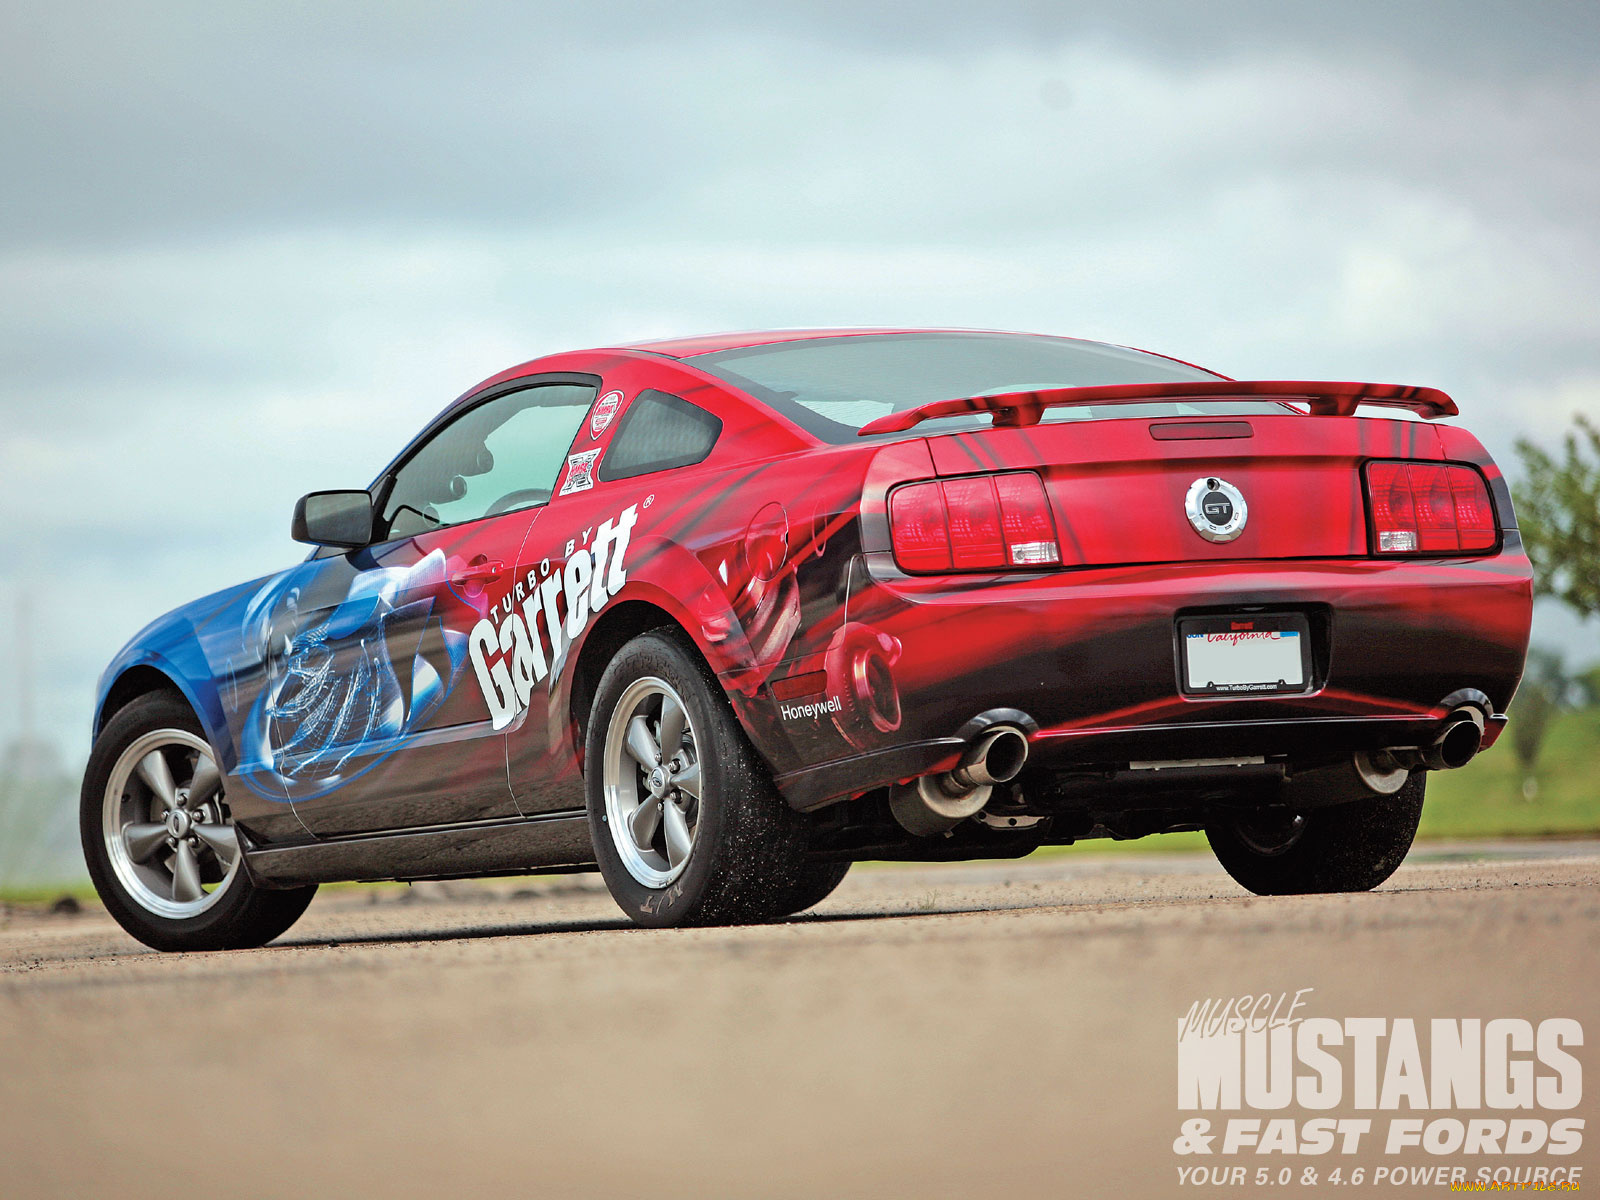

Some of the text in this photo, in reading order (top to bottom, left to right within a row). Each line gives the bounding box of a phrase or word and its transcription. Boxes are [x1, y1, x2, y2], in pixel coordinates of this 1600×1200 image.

[1205, 503, 1230, 514] GT
[490, 527, 592, 624] TURBO BY
[468, 503, 638, 730] Garrett
[781, 696, 842, 721] Honeywell
